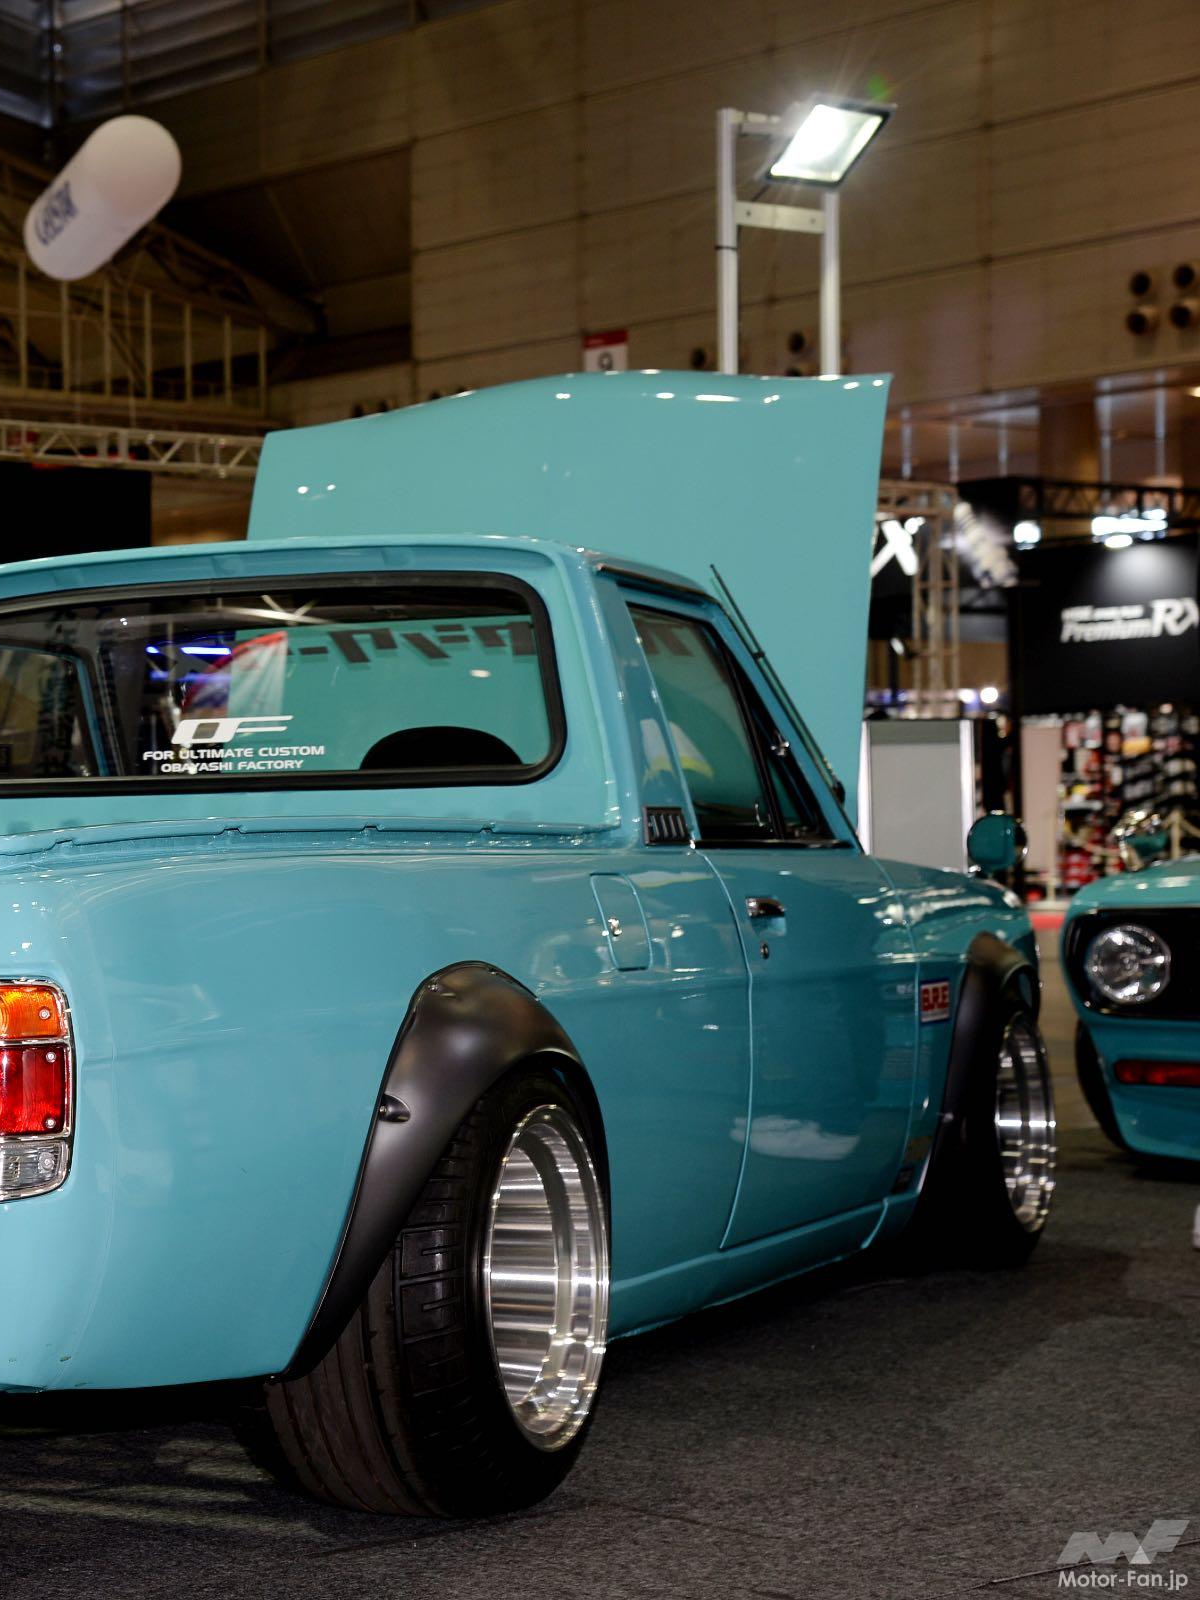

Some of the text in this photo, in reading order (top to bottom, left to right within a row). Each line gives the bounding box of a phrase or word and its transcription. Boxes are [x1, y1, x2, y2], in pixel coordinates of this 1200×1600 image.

[142, 745, 325, 761] FOR ULTIMATE CUSTOM
[160, 759, 304, 773] OBAYASHI FACTORY
